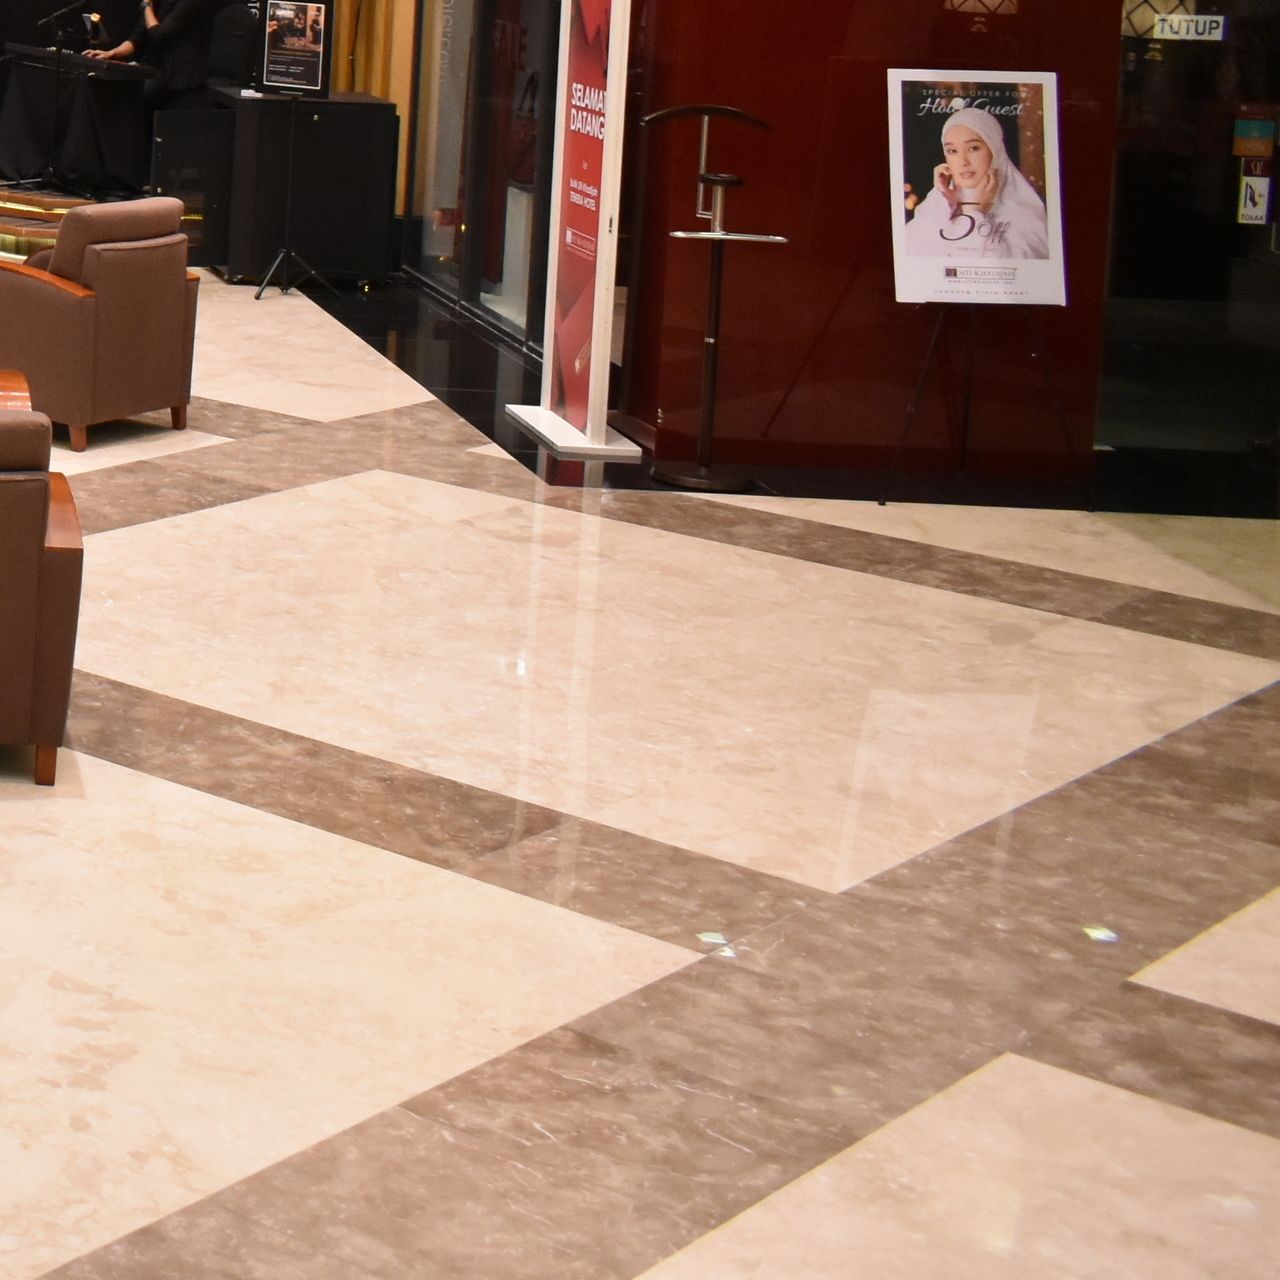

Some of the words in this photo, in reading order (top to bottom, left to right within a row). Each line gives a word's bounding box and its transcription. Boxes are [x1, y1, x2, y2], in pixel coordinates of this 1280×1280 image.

[1158, 19, 1220, 36] TUTUP
[969, 89, 1000, 98] OFFER
[570, 108, 605, 141] DATANG
